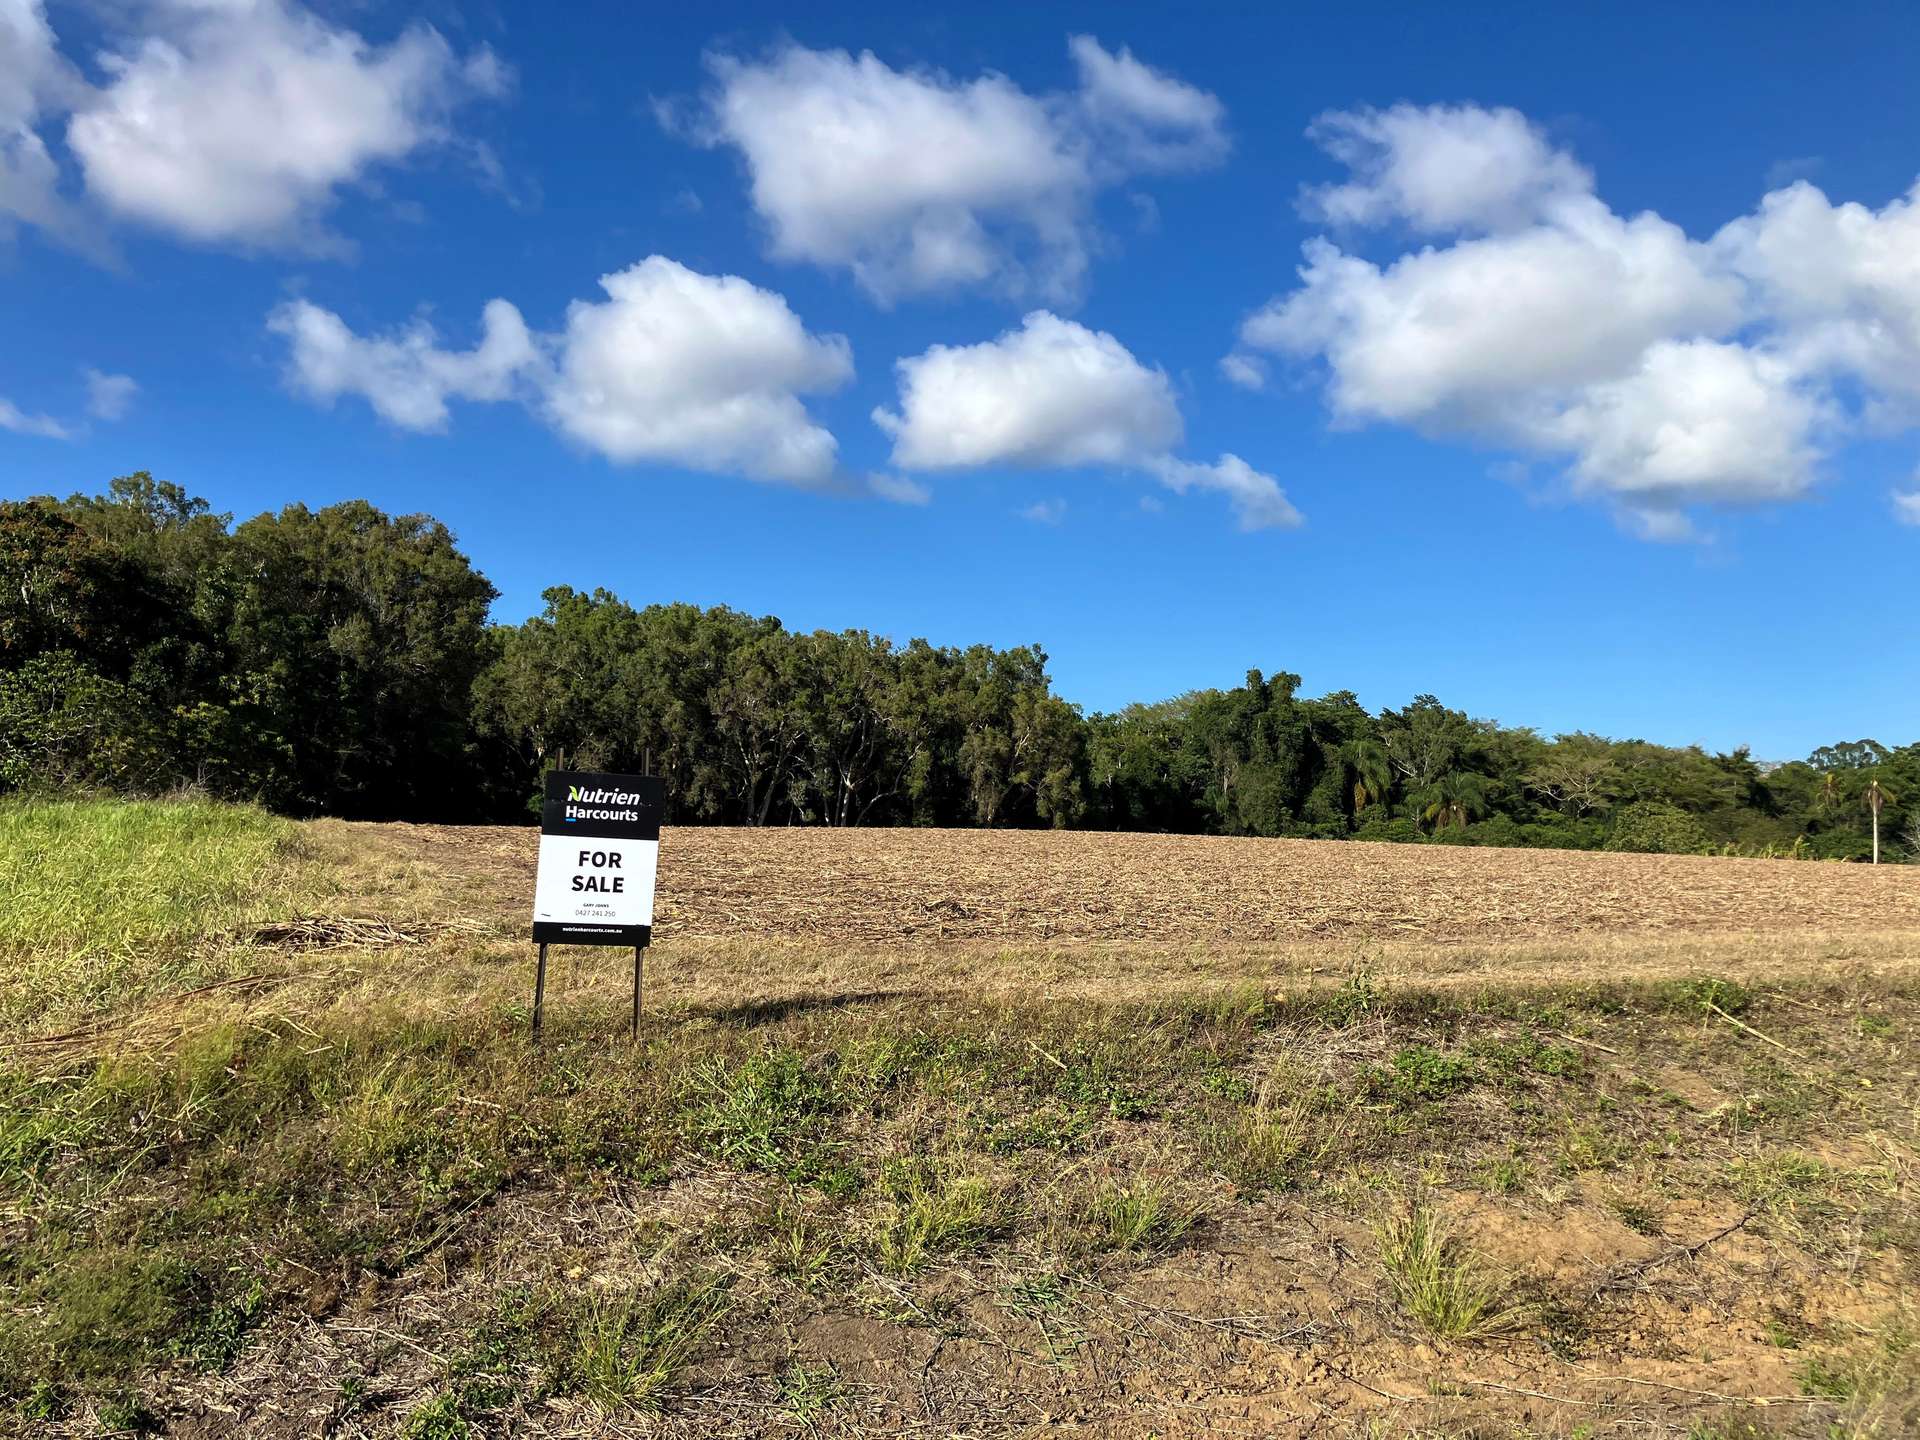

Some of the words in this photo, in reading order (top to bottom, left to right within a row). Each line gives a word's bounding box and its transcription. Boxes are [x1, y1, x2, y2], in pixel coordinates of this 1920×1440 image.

[568, 785, 640, 806] Nutrien
[565, 805, 639, 822] Harcourts
[578, 850, 622, 869] FOR
[571, 875, 624, 893] SALE
[575, 909, 590, 917] 0427
